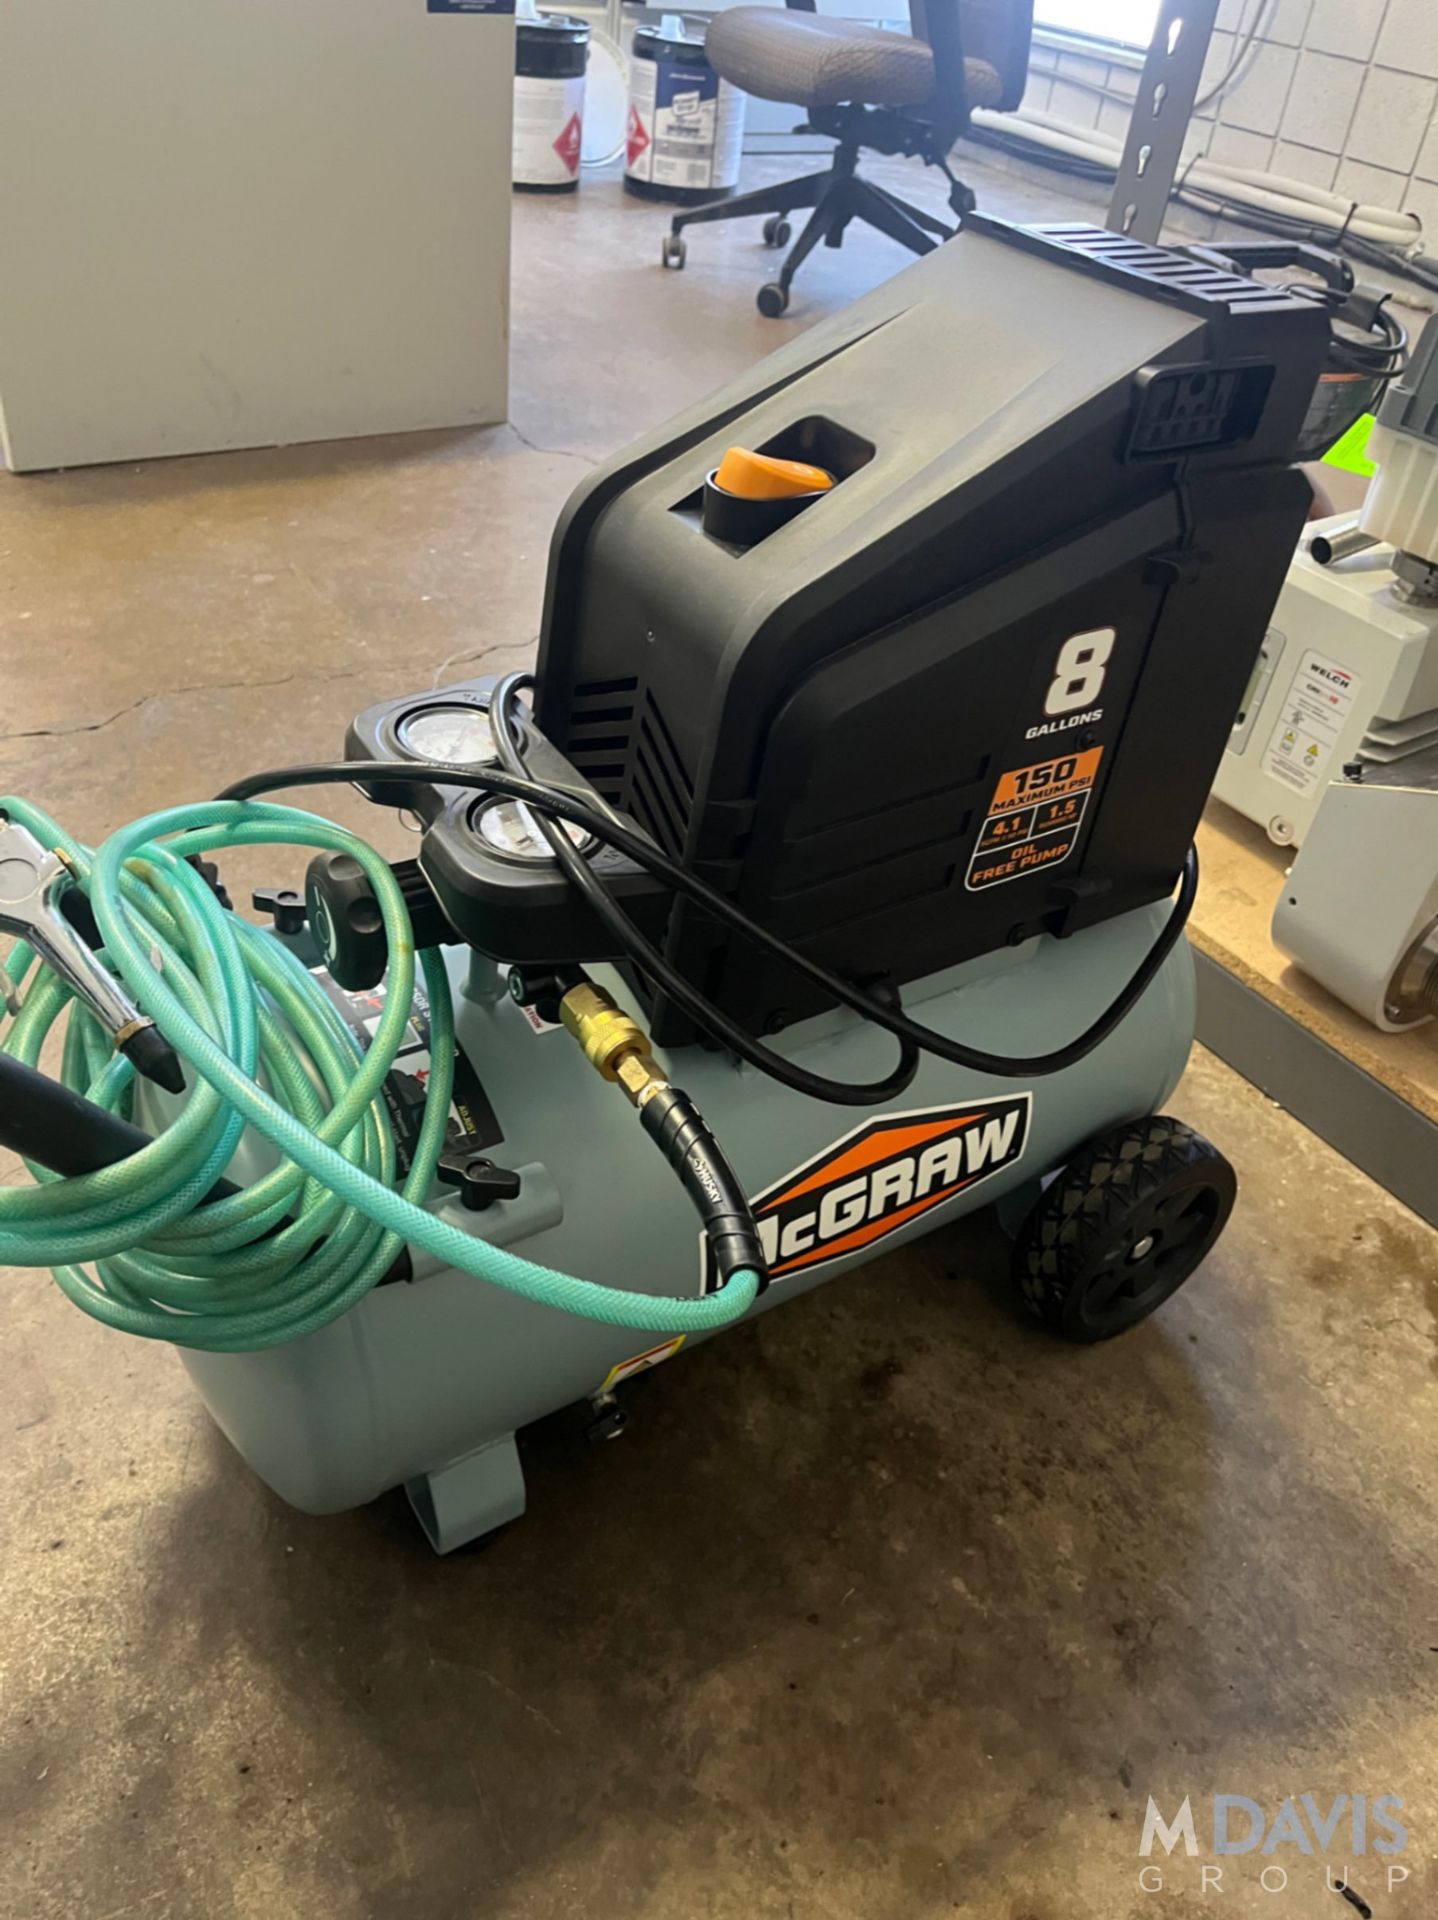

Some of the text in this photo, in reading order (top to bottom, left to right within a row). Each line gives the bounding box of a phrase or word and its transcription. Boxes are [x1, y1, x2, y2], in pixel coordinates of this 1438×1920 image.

[1045, 627, 1115, 715] 8
[1311, 663, 1349, 688] WELCH
[1025, 709, 1103, 740] GALLONS
[1013, 757, 1077, 794] 150
[991, 776, 1092, 812] MAXIMUM PSI
[1050, 799, 1077, 818] 1.5
[993, 816, 1022, 835] 4.1
[971, 843, 1069, 884] FREE PUMP
[1011, 844, 1037, 860] OIL
[458, 1105, 477, 1135] ADJUST
[700, 1170, 722, 1203] HUSKY
